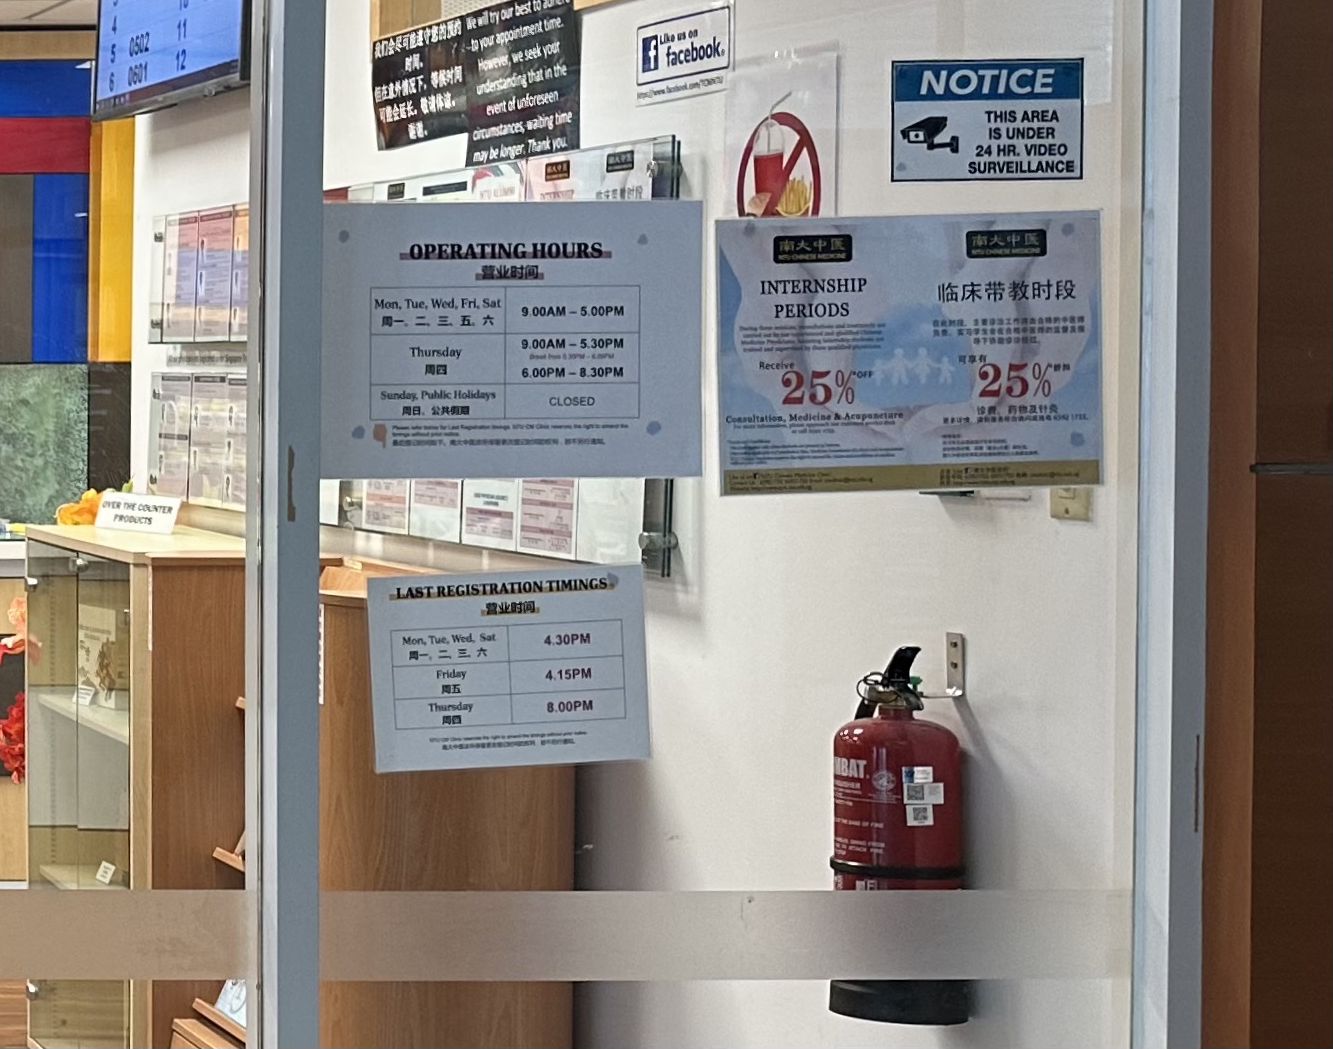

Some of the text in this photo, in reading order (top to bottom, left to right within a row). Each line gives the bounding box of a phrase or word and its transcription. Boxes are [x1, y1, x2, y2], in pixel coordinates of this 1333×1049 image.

[466, 17, 476, 30] We
[477, 12, 488, 28] will
[490, 10, 499, 24] try
[501, 6, 513, 20] our
[515, 2, 531, 16] best
[533, 0, 541, 11] to
[111, 16, 117, 35] 4
[177, 18, 187, 40] 11
[471, 17, 564, 53] to your appointment time.
[660, 29, 698, 45] Like us on
[129, 32, 150, 57] 0502
[111, 44, 116, 63] 5
[176, 49, 186, 71] 12
[478, 42, 560, 70] However, we seek your
[109, 72, 114, 92] 6
[477, 64, 567, 95] understanding that in the
[920, 68, 1055, 95] NOTICE
[486, 91, 558, 115] event of unforeseen
[985, 110, 1059, 123] THIS AREA
[473, 110, 572, 141] circumstances, waiting time
[989, 127, 1055, 140] IS UNDER
[473, 136, 567, 163] may be longer. Thank you.
[976, 144, 1067, 157] 24 HR. VIDEO
[968, 160, 1074, 174] SURVEILLANCE
[779, 238, 845, 252] 南大中医
[972, 233, 1039, 246] 南大中医
[410, 242, 602, 260] OPERATING HOURS
[482, 265, 538, 279] 营业时间
[760, 278, 867, 295] INTERNSHIP
[938, 280, 1076, 302] 临床带教时段
[375, 298, 501, 311] Mon, Tue, Wed, Fri, Sat
[522, 306, 566, 317] 9.00AM
[581, 306, 624, 316] 5.00PM
[775, 303, 850, 318] PERIODS
[522, 338, 565, 349] 9.00AM
[580, 338, 624, 349] 5.30PM
[410, 347, 462, 359] Thursday
[959, 355, 987, 364] 可享有
[425, 365, 447, 376] 周四
[522, 367, 565, 378] 6.00PM
[580, 367, 624, 378] 8.30PM
[759, 361, 794, 370] Receive
[782, 370, 855, 405] 25%
[979, 363, 1051, 398] 25%
[381, 390, 496, 401] Sunday, Public Holidays
[549, 397, 595, 406] CLOSED
[726, 415, 786, 423] Consultation,
[789, 414, 831, 422] Medicine
[844, 412, 903, 422] Acupuncture
[102, 501, 173, 514] OVER THE COUNTER
[113, 514, 152, 525] PRODUCTS
[396, 578, 607, 599] LAST REGISTRATION TIMINGS
[486, 601, 535, 615] 营业时间
[402, 633, 496, 645] Mon, Tue, Wed, Sat
[544, 633, 590, 646] 4.30PM
[436, 670, 466, 680] Friday
[546, 668, 592, 680] 4.15PM
[441, 684, 461, 694] 周五
[428, 702, 473, 712] Thursday
[547, 700, 593, 713] 8.00PM
[442, 715, 461, 725] 周四
